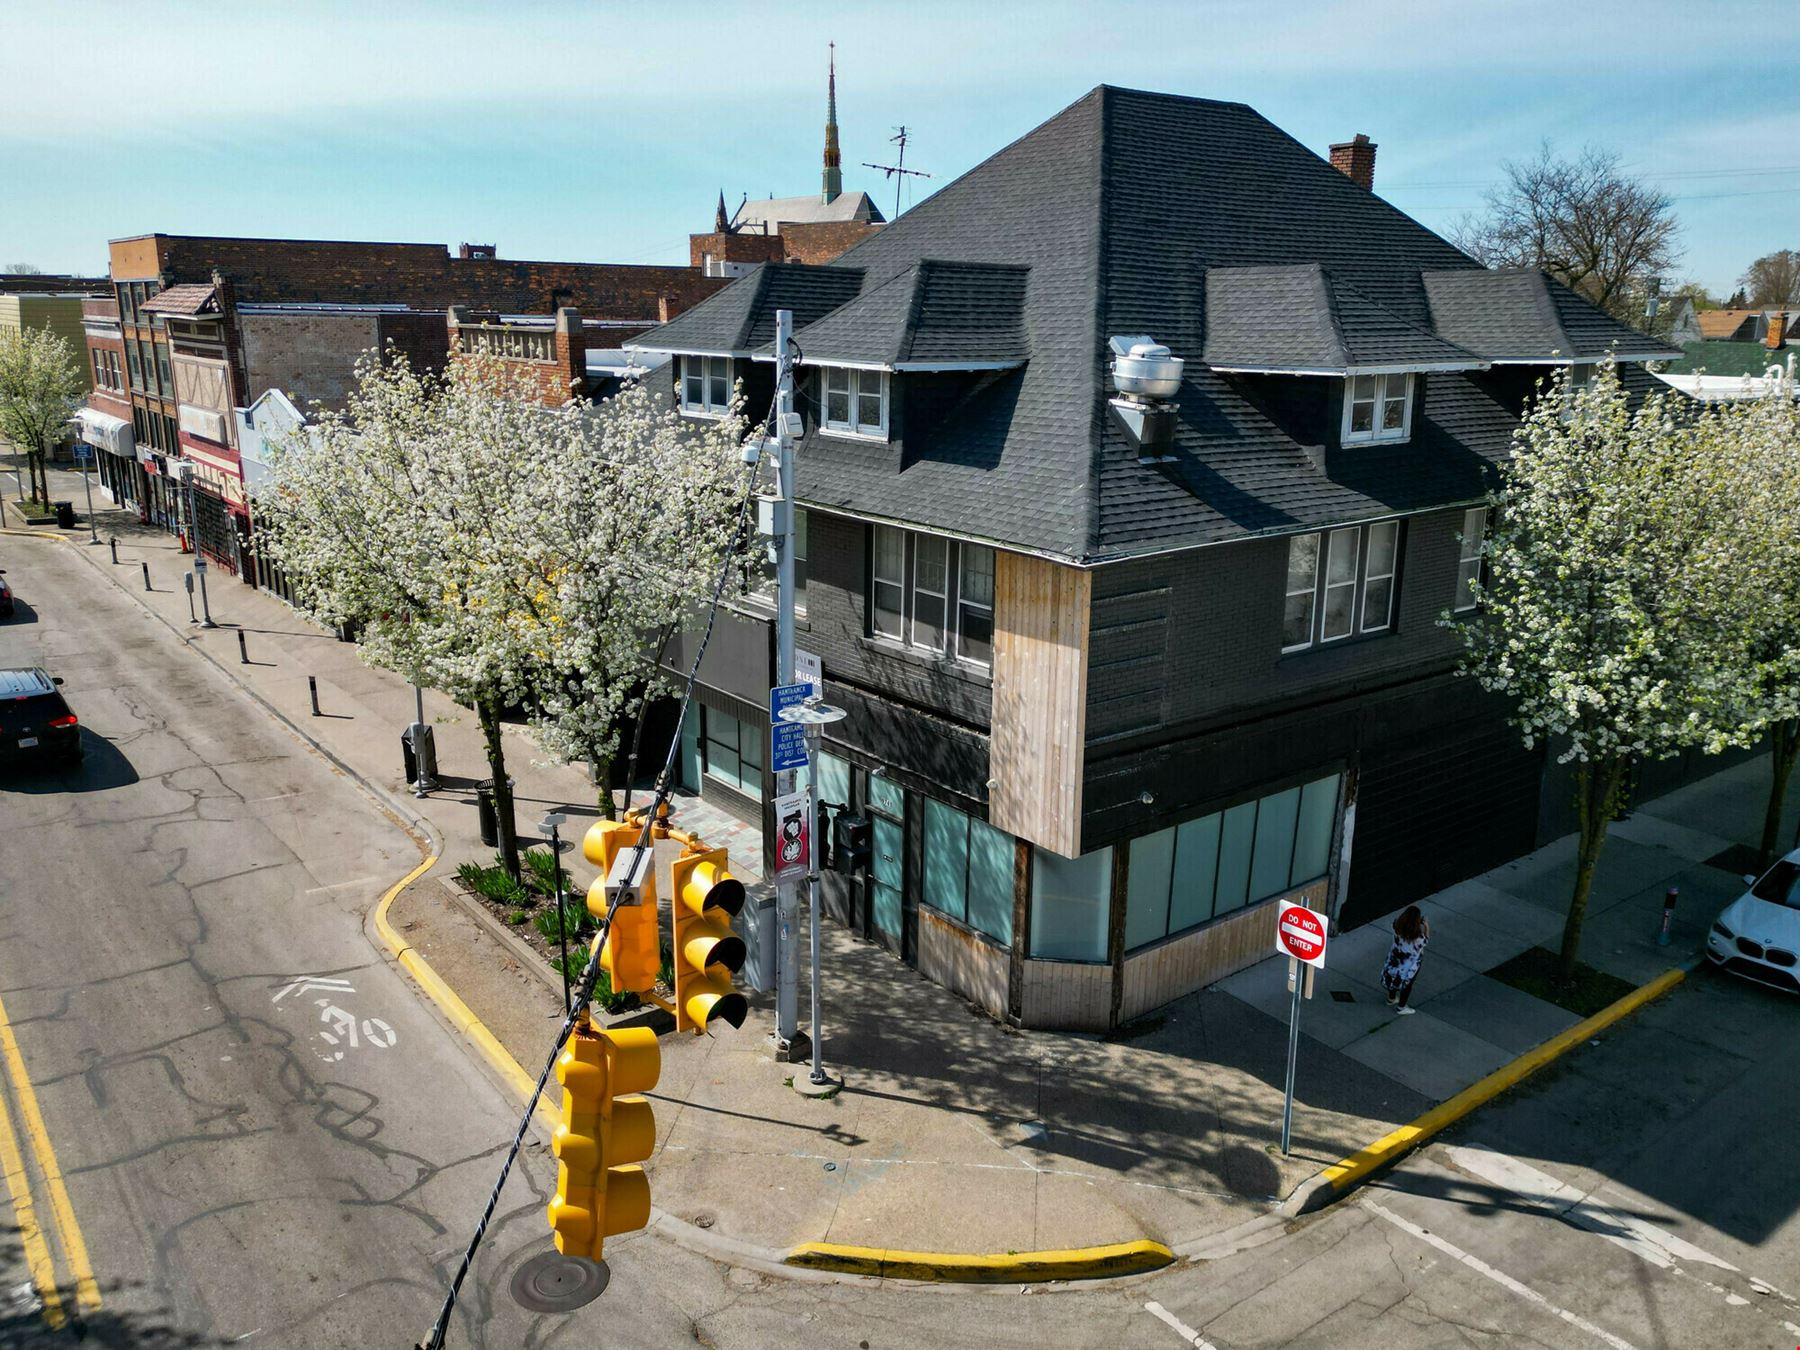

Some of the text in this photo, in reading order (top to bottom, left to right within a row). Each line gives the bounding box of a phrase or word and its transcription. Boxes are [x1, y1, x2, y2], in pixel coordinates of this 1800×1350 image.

[802, 673, 821, 686] LEASE
[780, 724, 803, 734] HAMTRAMC
[781, 734, 792, 743] CITY
[778, 741, 794, 751] POLICE
[784, 749, 795, 758] DIST
[1288, 914, 1317, 931] DO NOT
[1289, 937, 1312, 952] ENTER
